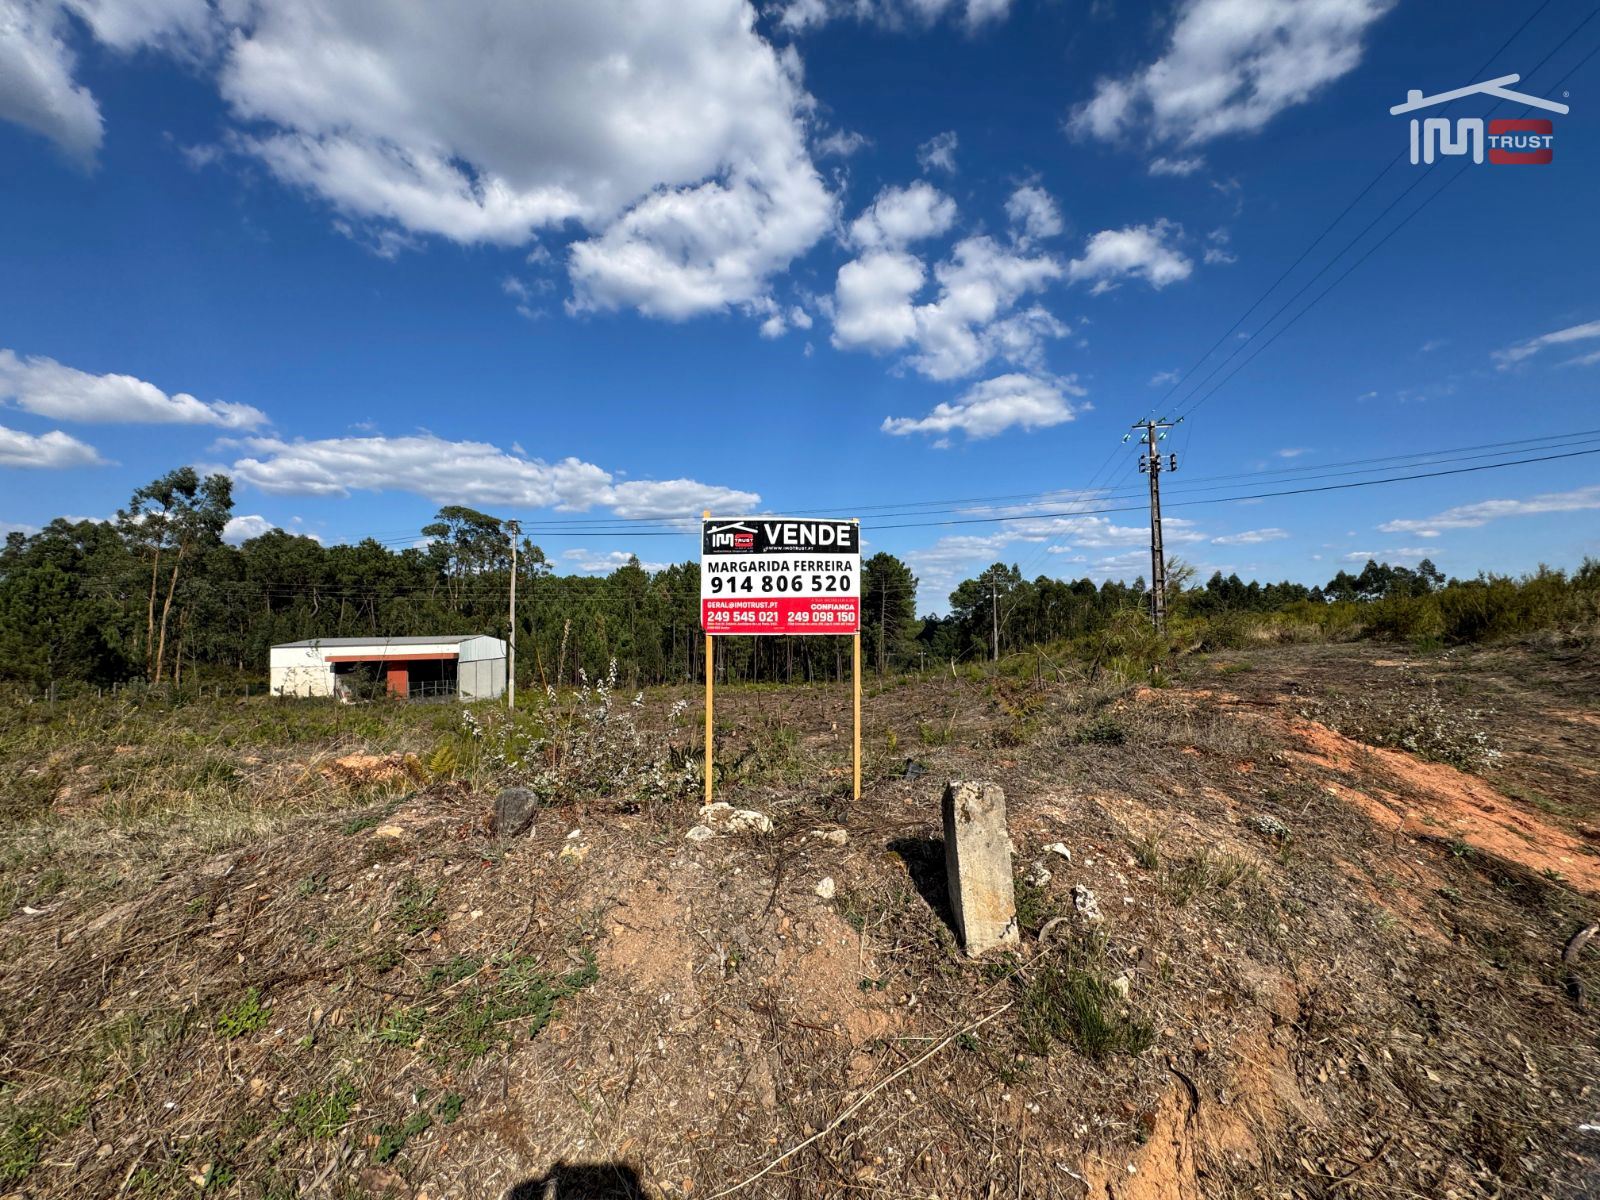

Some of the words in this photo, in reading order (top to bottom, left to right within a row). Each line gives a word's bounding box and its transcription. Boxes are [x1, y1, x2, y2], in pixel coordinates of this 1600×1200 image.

[764, 523, 851, 546] VENDE
[707, 561, 790, 573] MARGARIDA
[793, 560, 853, 572] FERREIRA
[711, 576, 753, 593] 914
[761, 575, 803, 592] 806
[811, 575, 851, 592] 520
[707, 601, 778, 609] GERAL@IMOTRUST.PT
[707, 611, 730, 622] 249
[733, 611, 756, 622] 545
[758, 611, 779, 622] 021
[787, 611, 810, 622] 249
[812, 611, 834, 622] 098
[836, 611, 855, 622] 150
